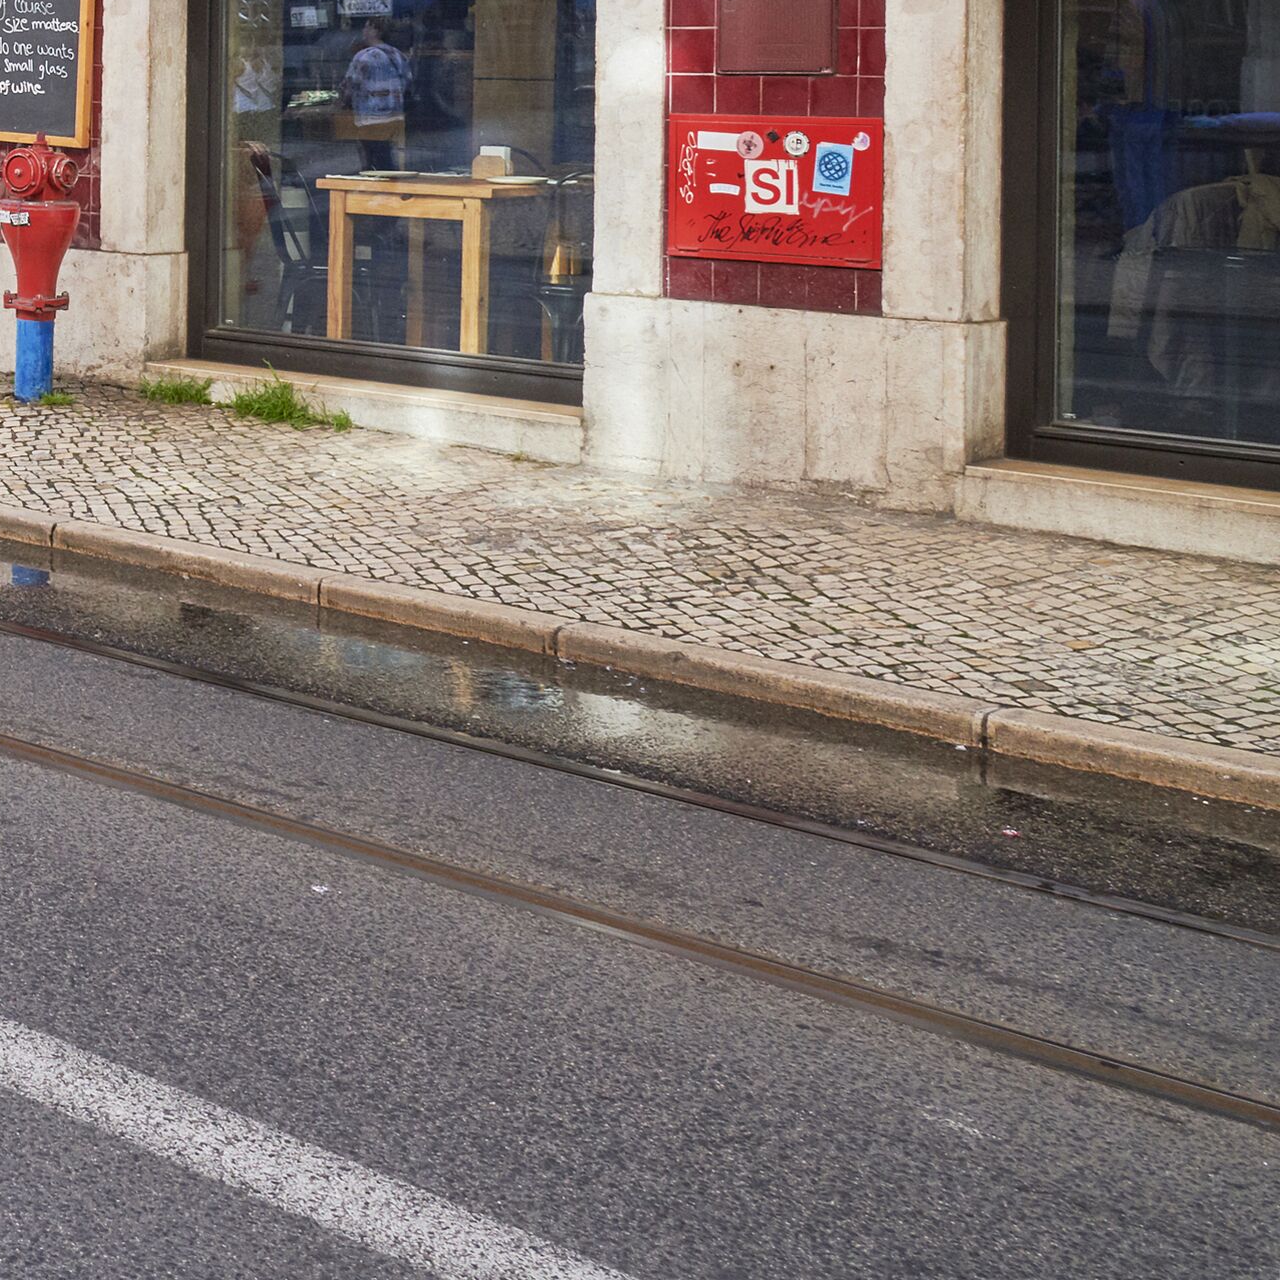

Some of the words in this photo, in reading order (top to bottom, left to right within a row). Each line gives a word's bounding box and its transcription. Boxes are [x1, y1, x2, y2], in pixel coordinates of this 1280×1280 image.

[13, 41, 34, 56] one
[37, 45, 75, 61] wants
[39, 64, 68, 80] glass
[751, 167, 794, 207] SI
